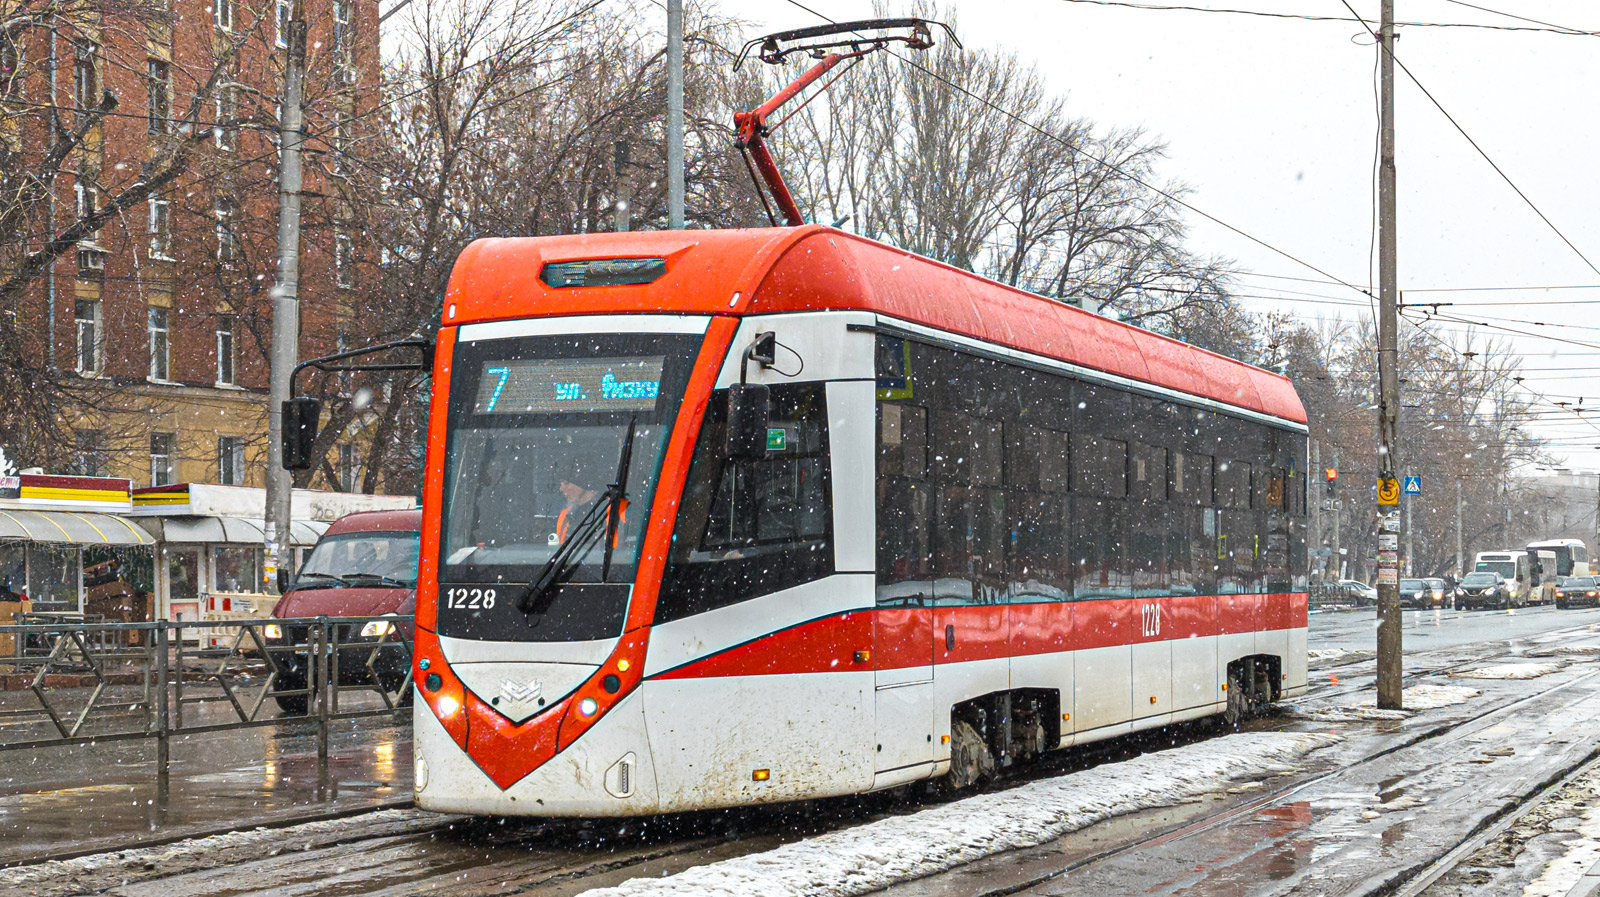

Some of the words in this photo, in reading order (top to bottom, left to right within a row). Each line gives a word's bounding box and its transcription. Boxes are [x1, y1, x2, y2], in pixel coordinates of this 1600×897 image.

[486, 366, 510, 412] 7
[555, 382, 587, 401] ул.
[447, 588, 497, 609] 1228
[1141, 603, 1161, 637] 1228
